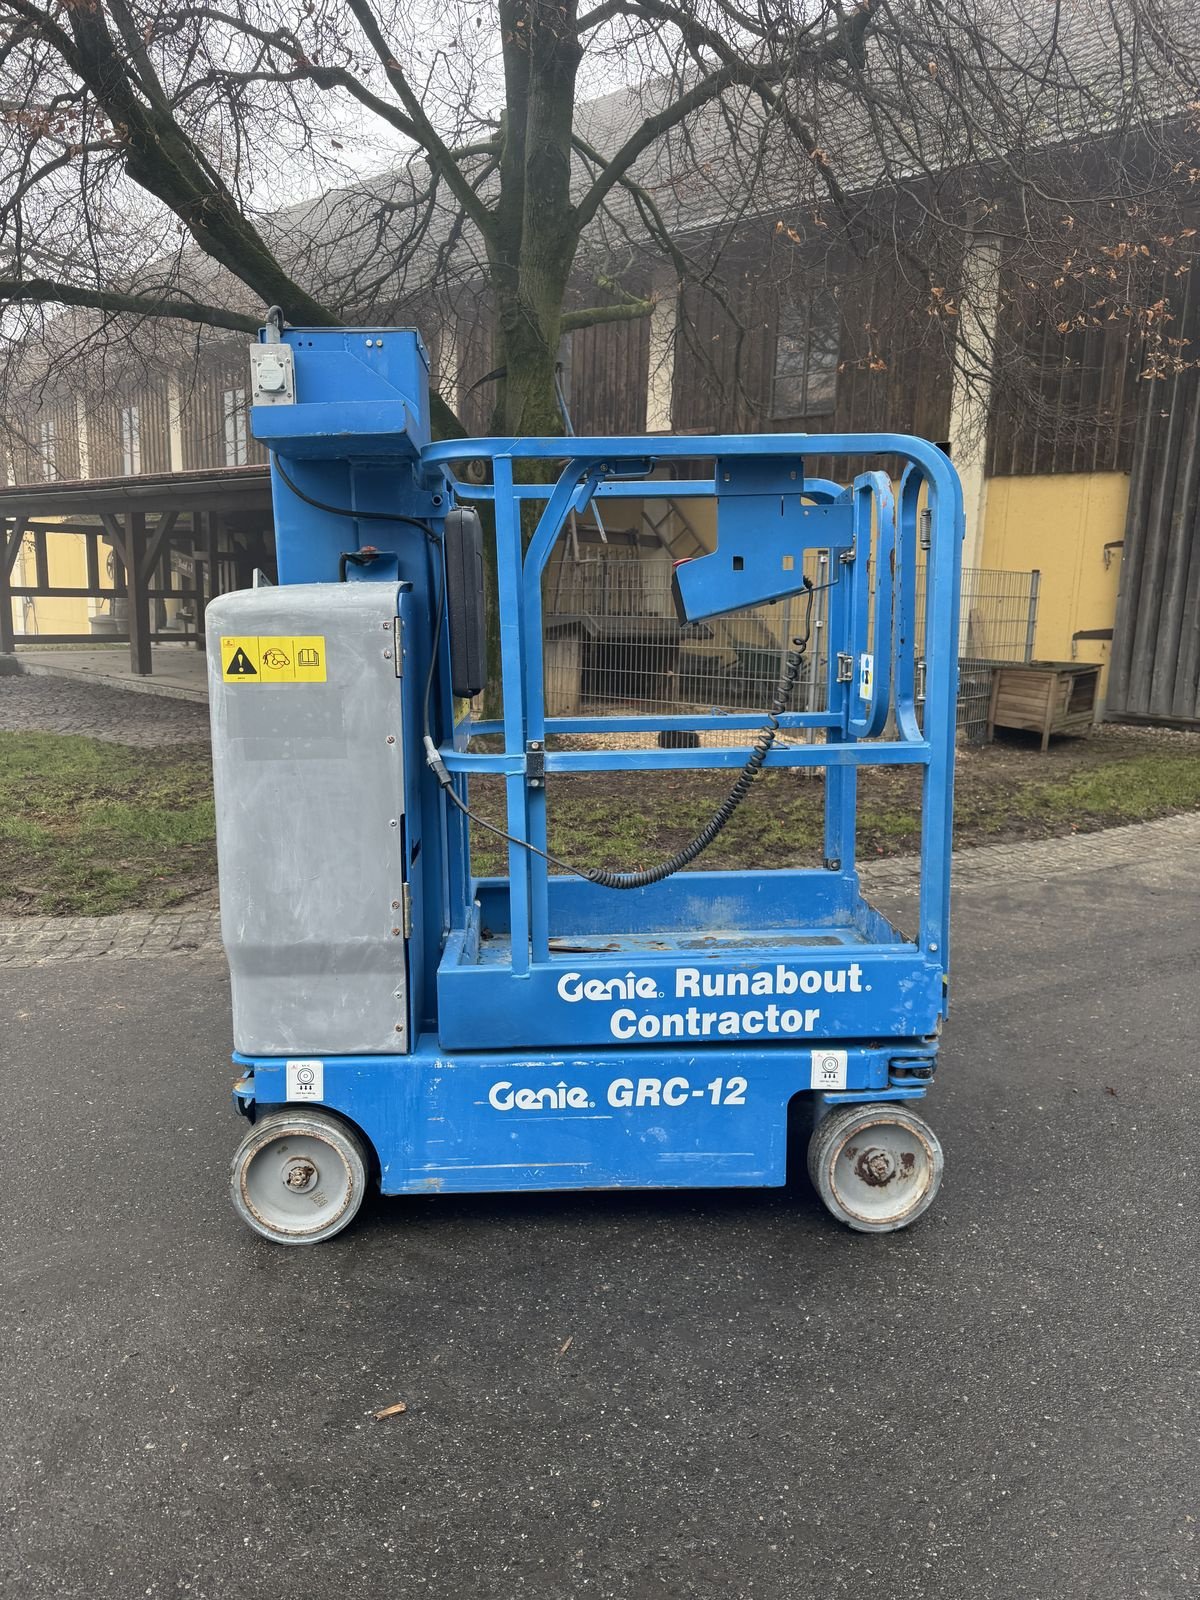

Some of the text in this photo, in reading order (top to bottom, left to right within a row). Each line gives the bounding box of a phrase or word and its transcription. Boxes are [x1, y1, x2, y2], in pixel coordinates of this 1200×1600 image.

[557, 963, 863, 1003] Genie Runabout
[610, 1004, 820, 1040] Contractor
[488, 1076, 748, 1111] Genie GRC-12
